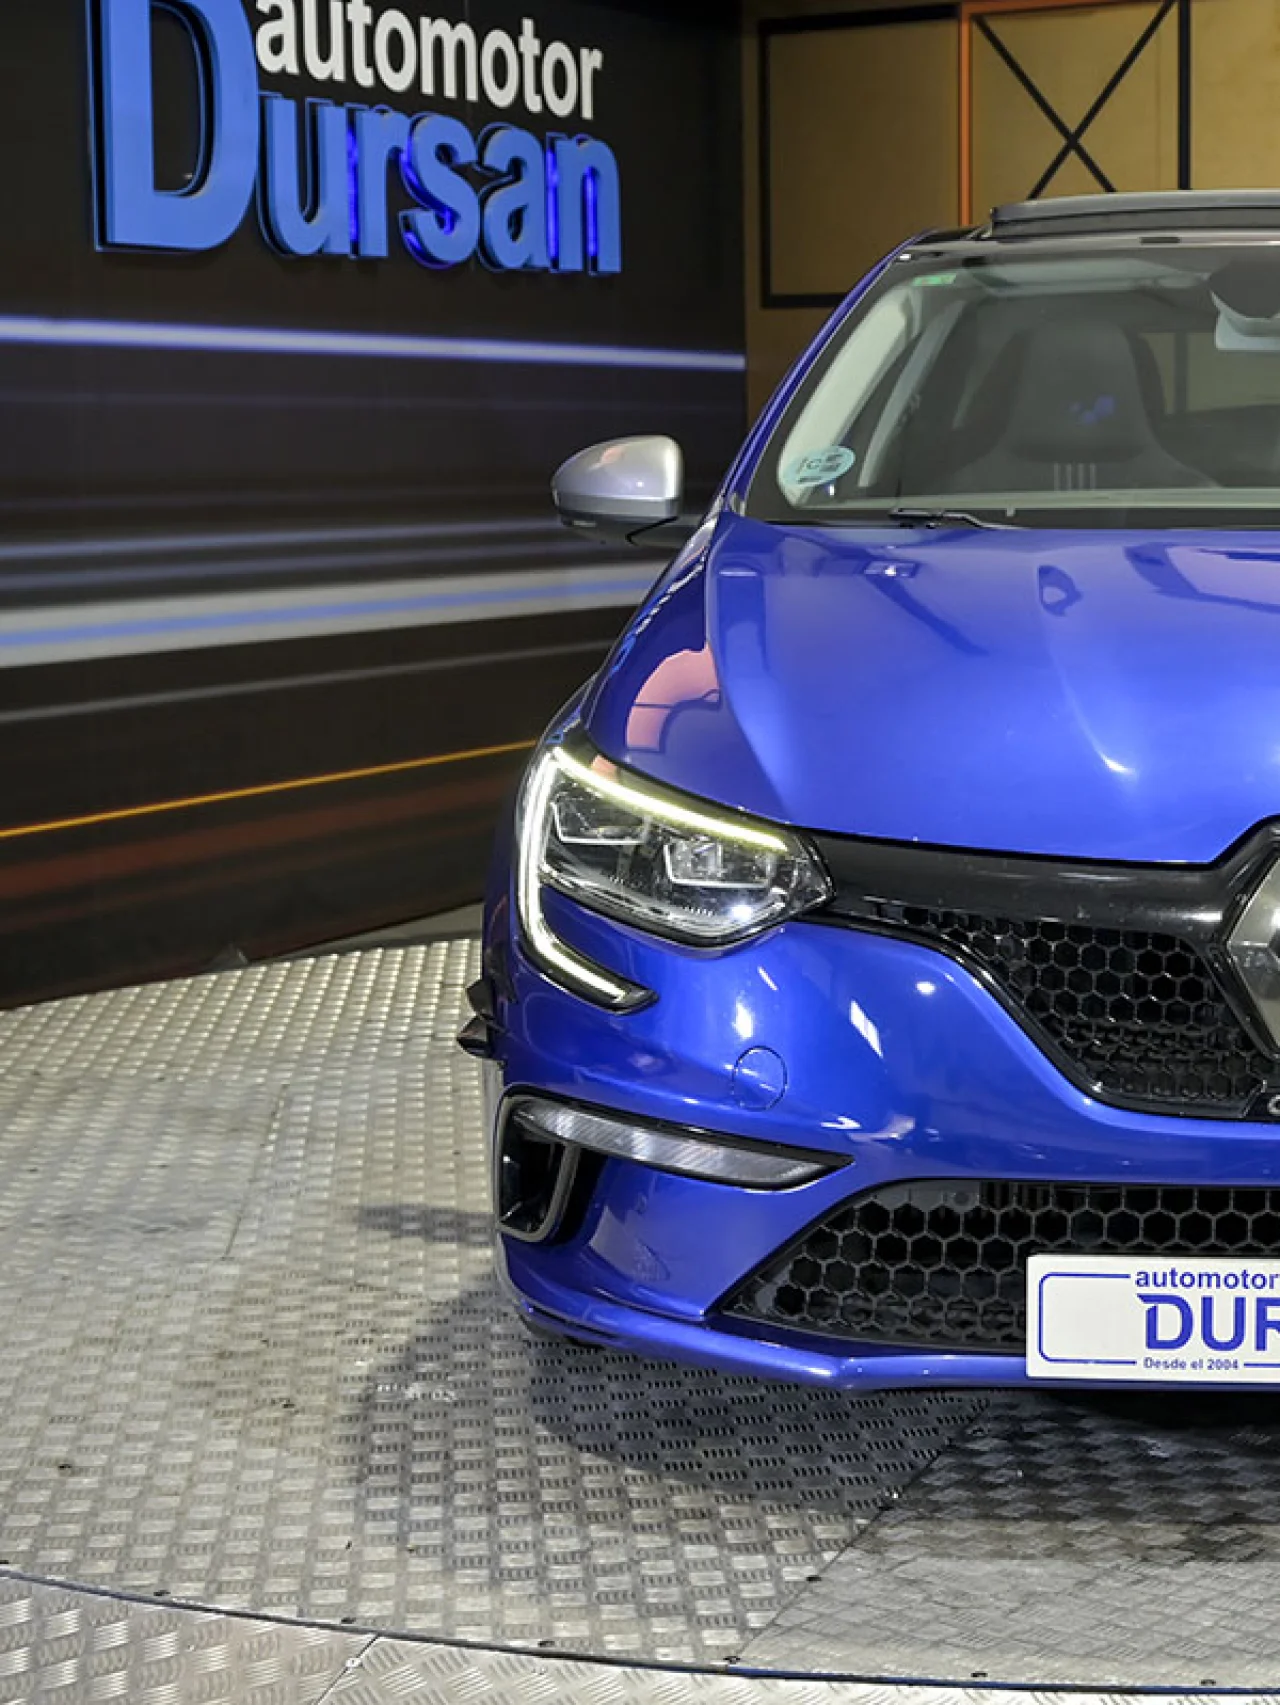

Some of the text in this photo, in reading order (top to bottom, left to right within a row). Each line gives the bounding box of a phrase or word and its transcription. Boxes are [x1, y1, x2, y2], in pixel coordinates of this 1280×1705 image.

[255, 0, 604, 120] automotor
[87, 0, 622, 274] Dursan
[1135, 1267, 1280, 1290] automotor
[1143, 1356, 1187, 1370] Desde
[1190, 1358, 1204, 1370] el
